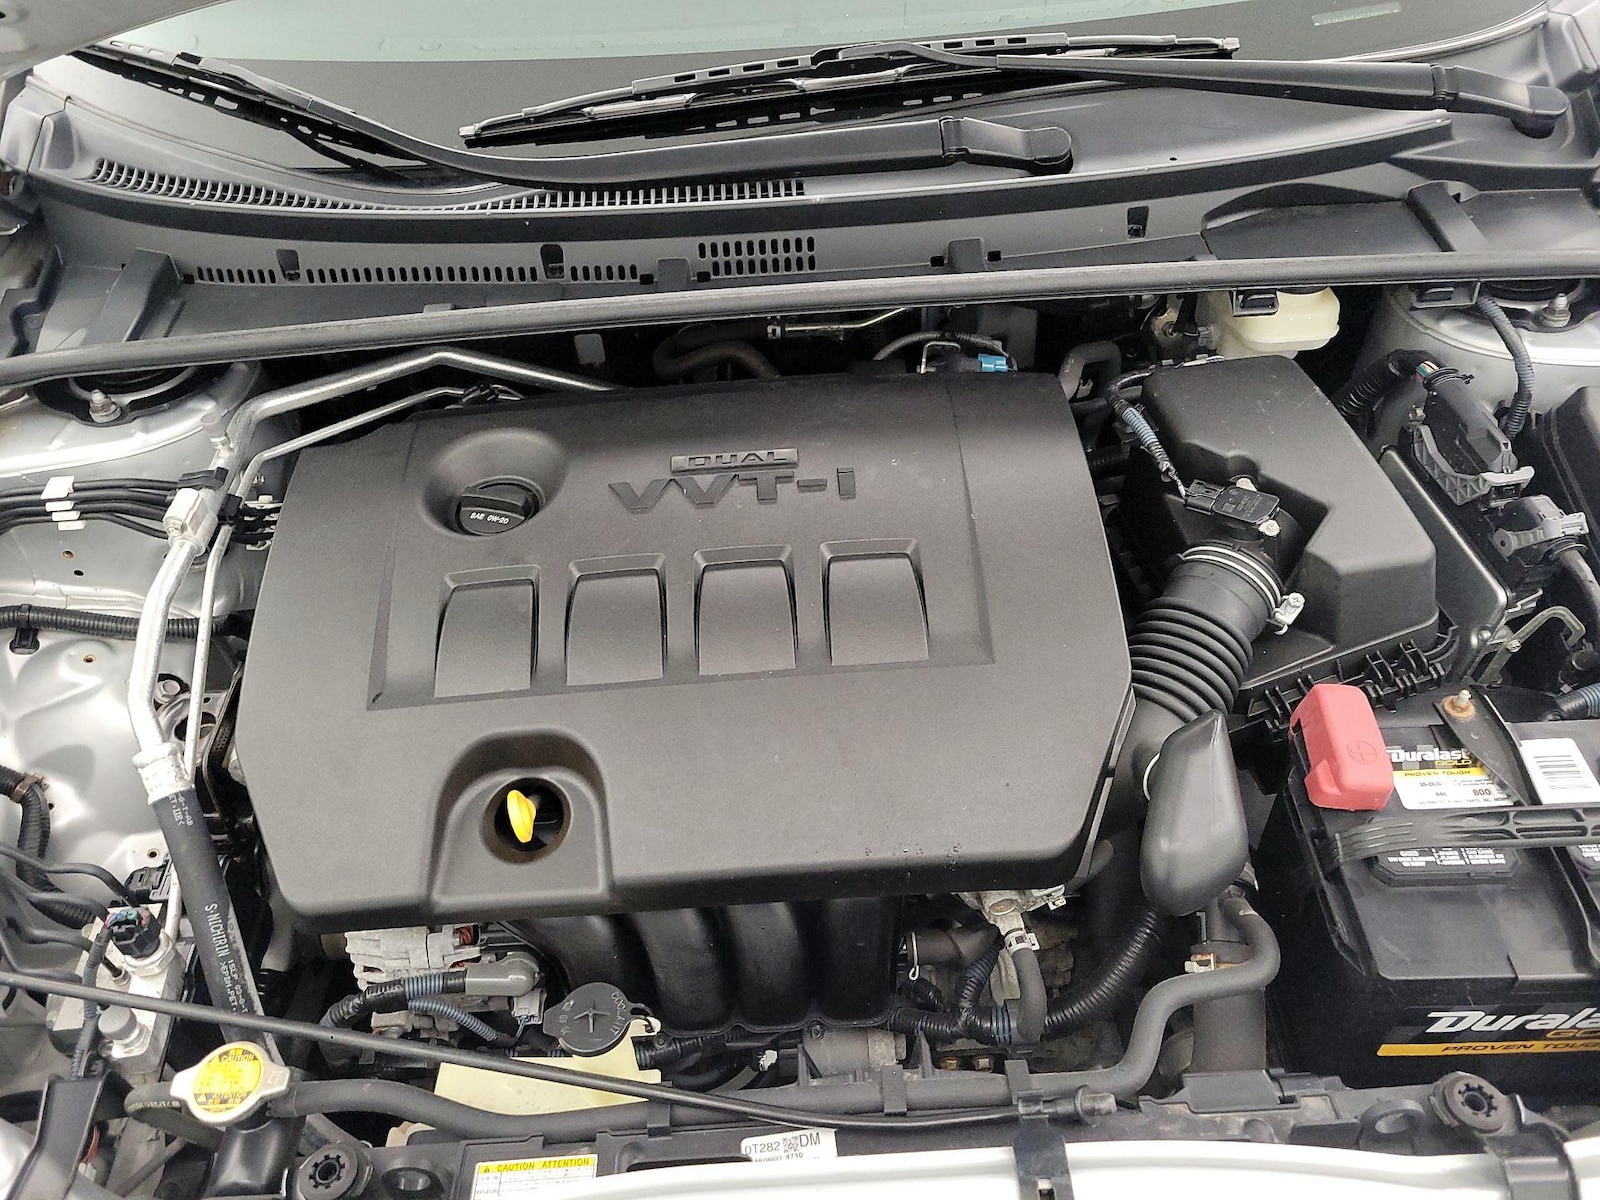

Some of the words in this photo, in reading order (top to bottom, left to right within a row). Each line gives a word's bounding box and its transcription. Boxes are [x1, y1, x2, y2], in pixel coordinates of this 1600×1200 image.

[688, 450, 788, 467] DUAL
[469, 512, 486, 520] SAE
[486, 514, 510, 525] 0W-20
[1385, 747, 1471, 763] Duralast
[1434, 759, 1473, 767] GOLD
[1472, 788, 1491, 796] 800
[1441, 1043, 1535, 1052] PROVEN
[221, 1054, 254, 1063] CAUTION
[799, 1132, 820, 1148] DM
[496, 1163, 535, 1172] CAUTION
[541, 1158, 590, 1168] ATTENTION
